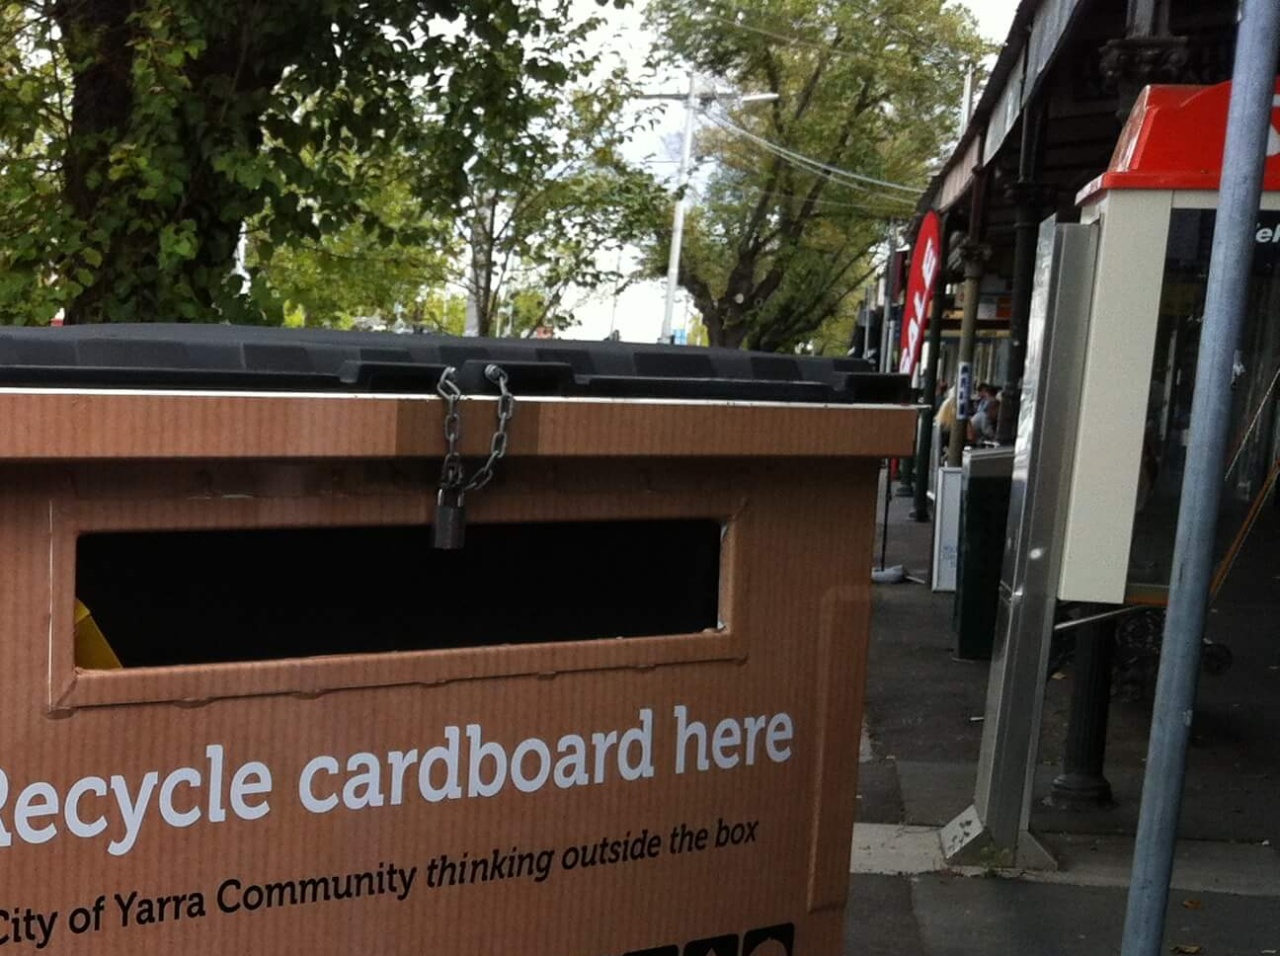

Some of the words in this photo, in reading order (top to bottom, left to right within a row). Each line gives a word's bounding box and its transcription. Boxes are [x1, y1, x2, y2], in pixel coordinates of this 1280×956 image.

[1255, 223, 1280, 243] el
[298, 708, 654, 814] cardboard
[674, 705, 793, 774] here
[68, 896, 105, 934] of
[115, 891, 206, 927] Yarra
[216, 862, 417, 914] Community
[426, 848, 555, 888] thinking
[561, 829, 662, 870] outside
[669, 823, 708, 855] the
[715, 817, 759, 848] box
